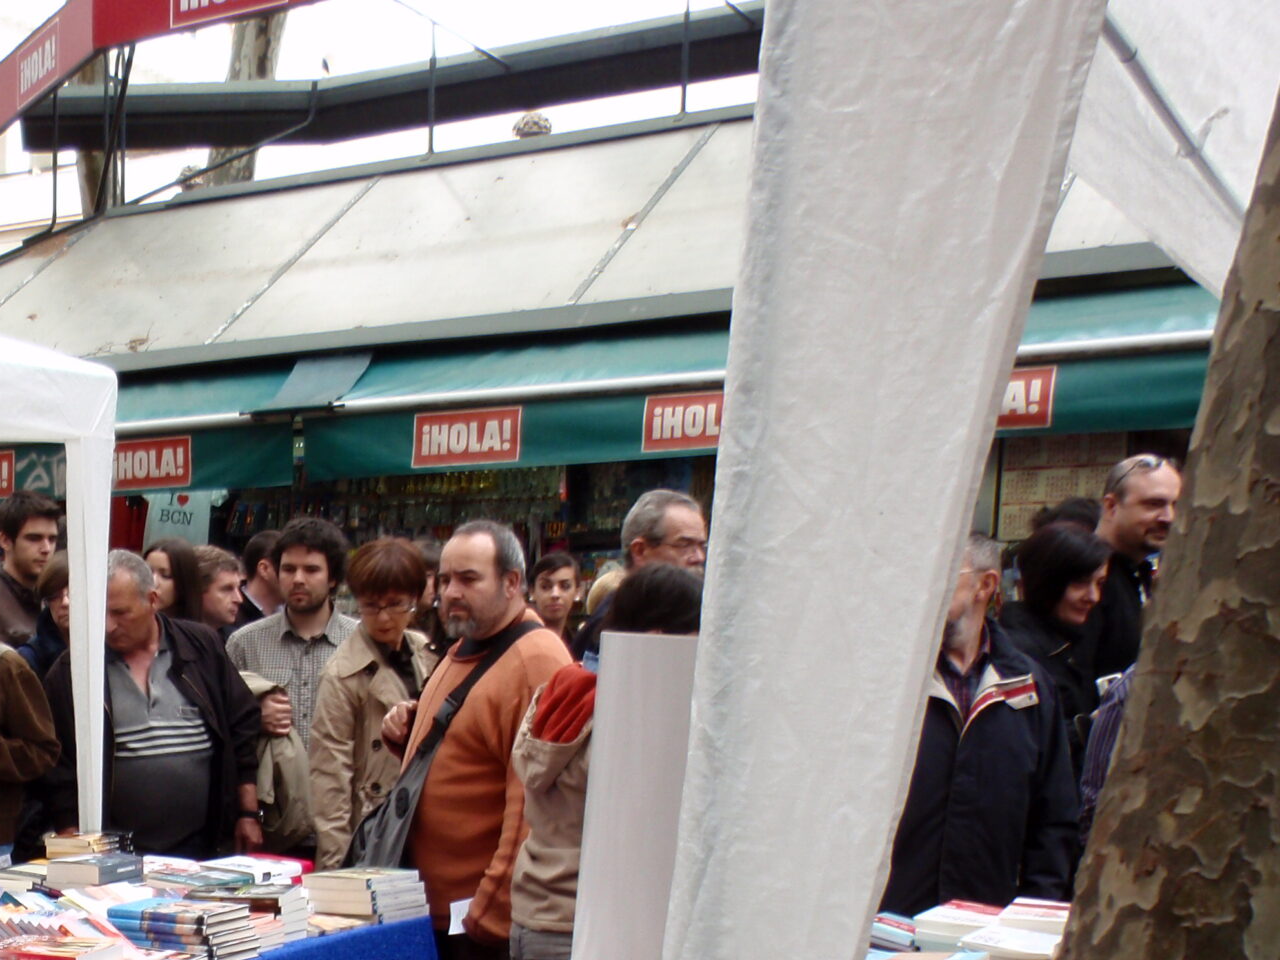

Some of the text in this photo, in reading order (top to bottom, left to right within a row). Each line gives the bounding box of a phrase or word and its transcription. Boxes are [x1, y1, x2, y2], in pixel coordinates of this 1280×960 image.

[20, 35, 56, 93] ¡HOLA!
[421, 418, 511, 456] ¡HOLA!
[652, 403, 720, 441] ¡HOL
[112, 447, 184, 479] ¡HOLA!
[158, 509, 194, 526] BCN
